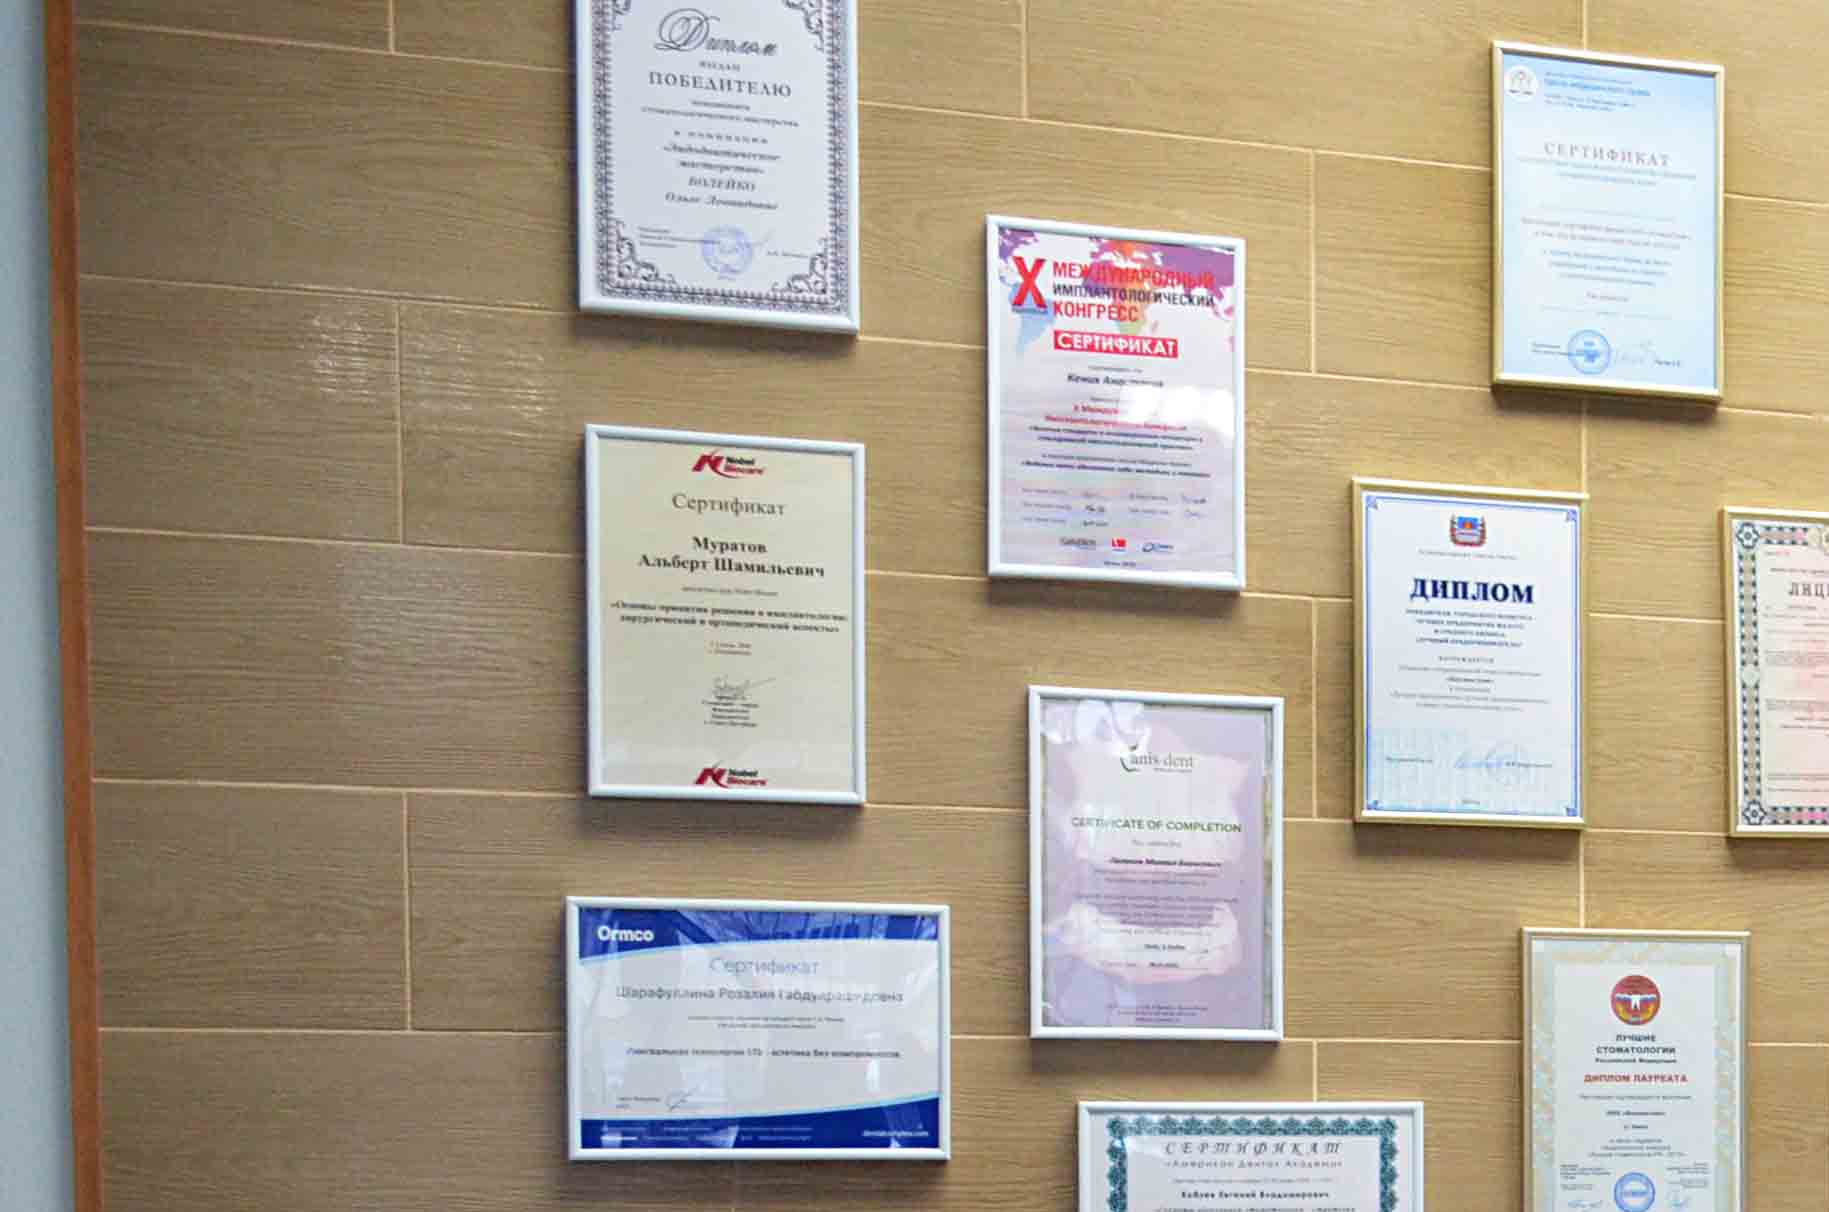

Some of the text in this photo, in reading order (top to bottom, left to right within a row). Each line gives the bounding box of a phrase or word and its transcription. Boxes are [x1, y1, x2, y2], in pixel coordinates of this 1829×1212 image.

[649, 71, 792, 98] ПОБЕДИТЕЛЮ
[1544, 143, 1670, 167] СЕРТИФИКАТ
[1053, 262, 1215, 289] МЕЖДУНАРОДНЫЙ
[1053, 284, 1217, 306] ИМПЛАНТОЛОГИЧЕСКИЙ
[1053, 303, 1139, 322] КОНГРЕСС
[1058, 332, 1176, 356] СЕРТИФИКАТ
[671, 494, 786, 516] Сертификат
[692, 536, 767, 554] Муратов
[638, 554, 825, 577] Альберт Шамильевич
[1410, 577, 1534, 604] ДИПЛОМ
[1072, 817, 1242, 833] CERTIFICATE OF COMPLETION
[597, 926, 655, 942] Ormco
[708, 957, 819, 977] Сертификат
